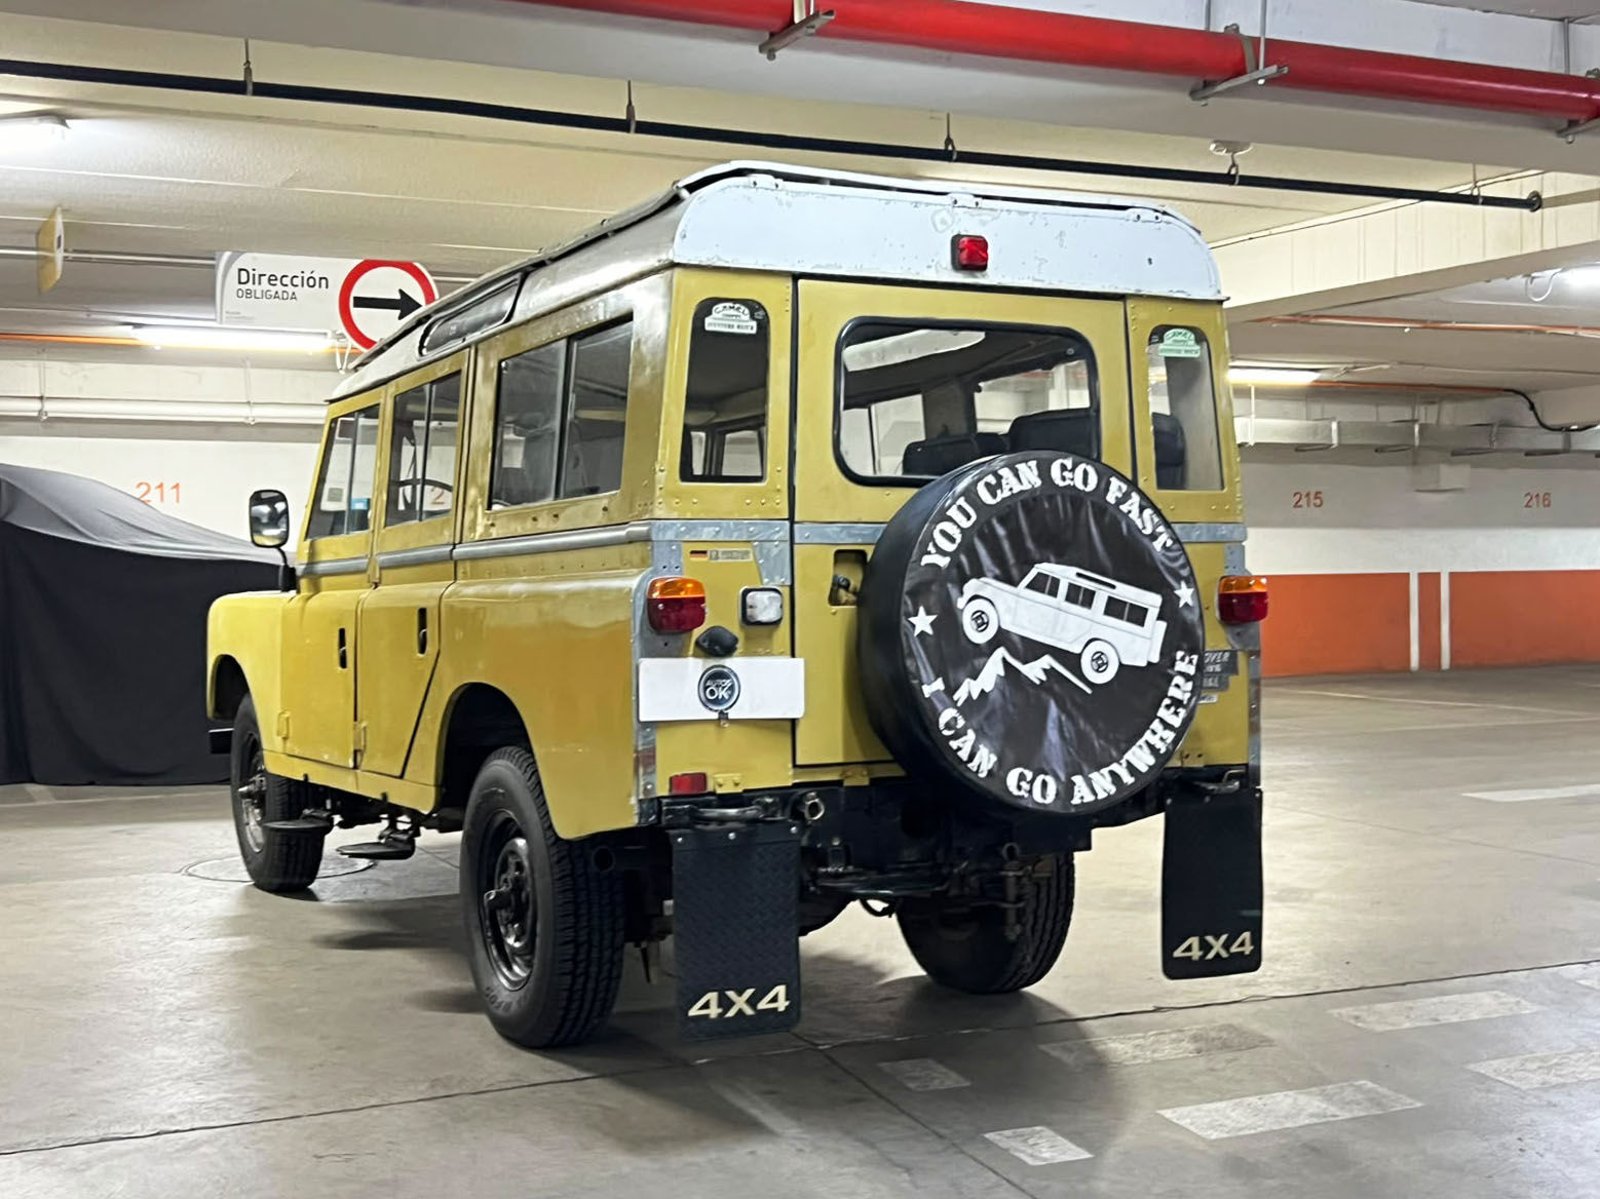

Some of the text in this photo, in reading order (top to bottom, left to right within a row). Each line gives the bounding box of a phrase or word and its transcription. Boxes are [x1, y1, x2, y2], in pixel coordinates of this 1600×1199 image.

[237, 267, 330, 290] Dirección
[236, 288, 298, 301] OBLIGADA
[135, 481, 182, 505] 211
[1292, 490, 1324, 509] 215
[1523, 491, 1552, 509] 216
[920, 457, 1173, 568] YOU CAN GO FAST
[921, 650, 1199, 806] I CAN GO ANYWHERE
[1172, 930, 1255, 961] 4X4
[687, 983, 792, 1019] 4X4
